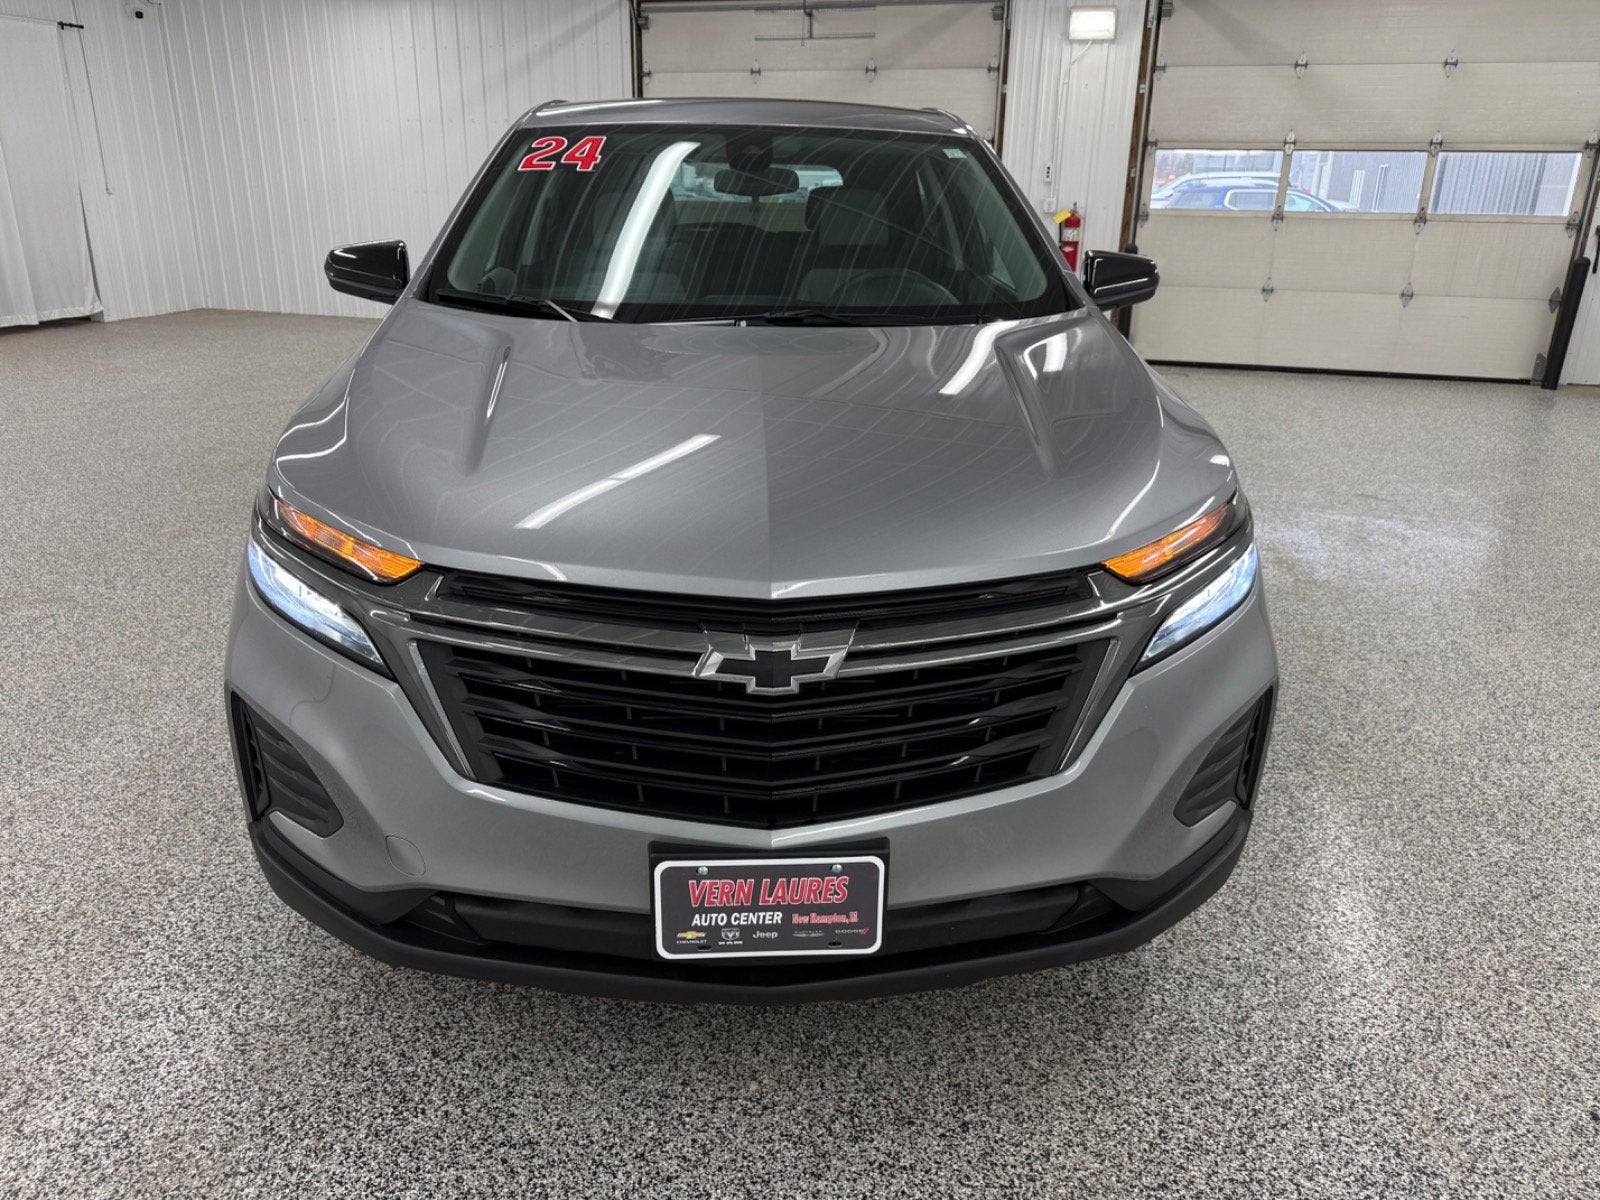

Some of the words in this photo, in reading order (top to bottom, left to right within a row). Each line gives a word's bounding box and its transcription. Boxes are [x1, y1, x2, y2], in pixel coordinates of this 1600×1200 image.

[518, 136, 607, 171] 24
[688, 879, 754, 907] VERN
[758, 876, 849, 906] LAURES
[691, 913, 728, 926] AUTO
[731, 911, 782, 926] CENTER
[792, 913, 809, 924] New
[752, 930, 778, 939] Jeep
